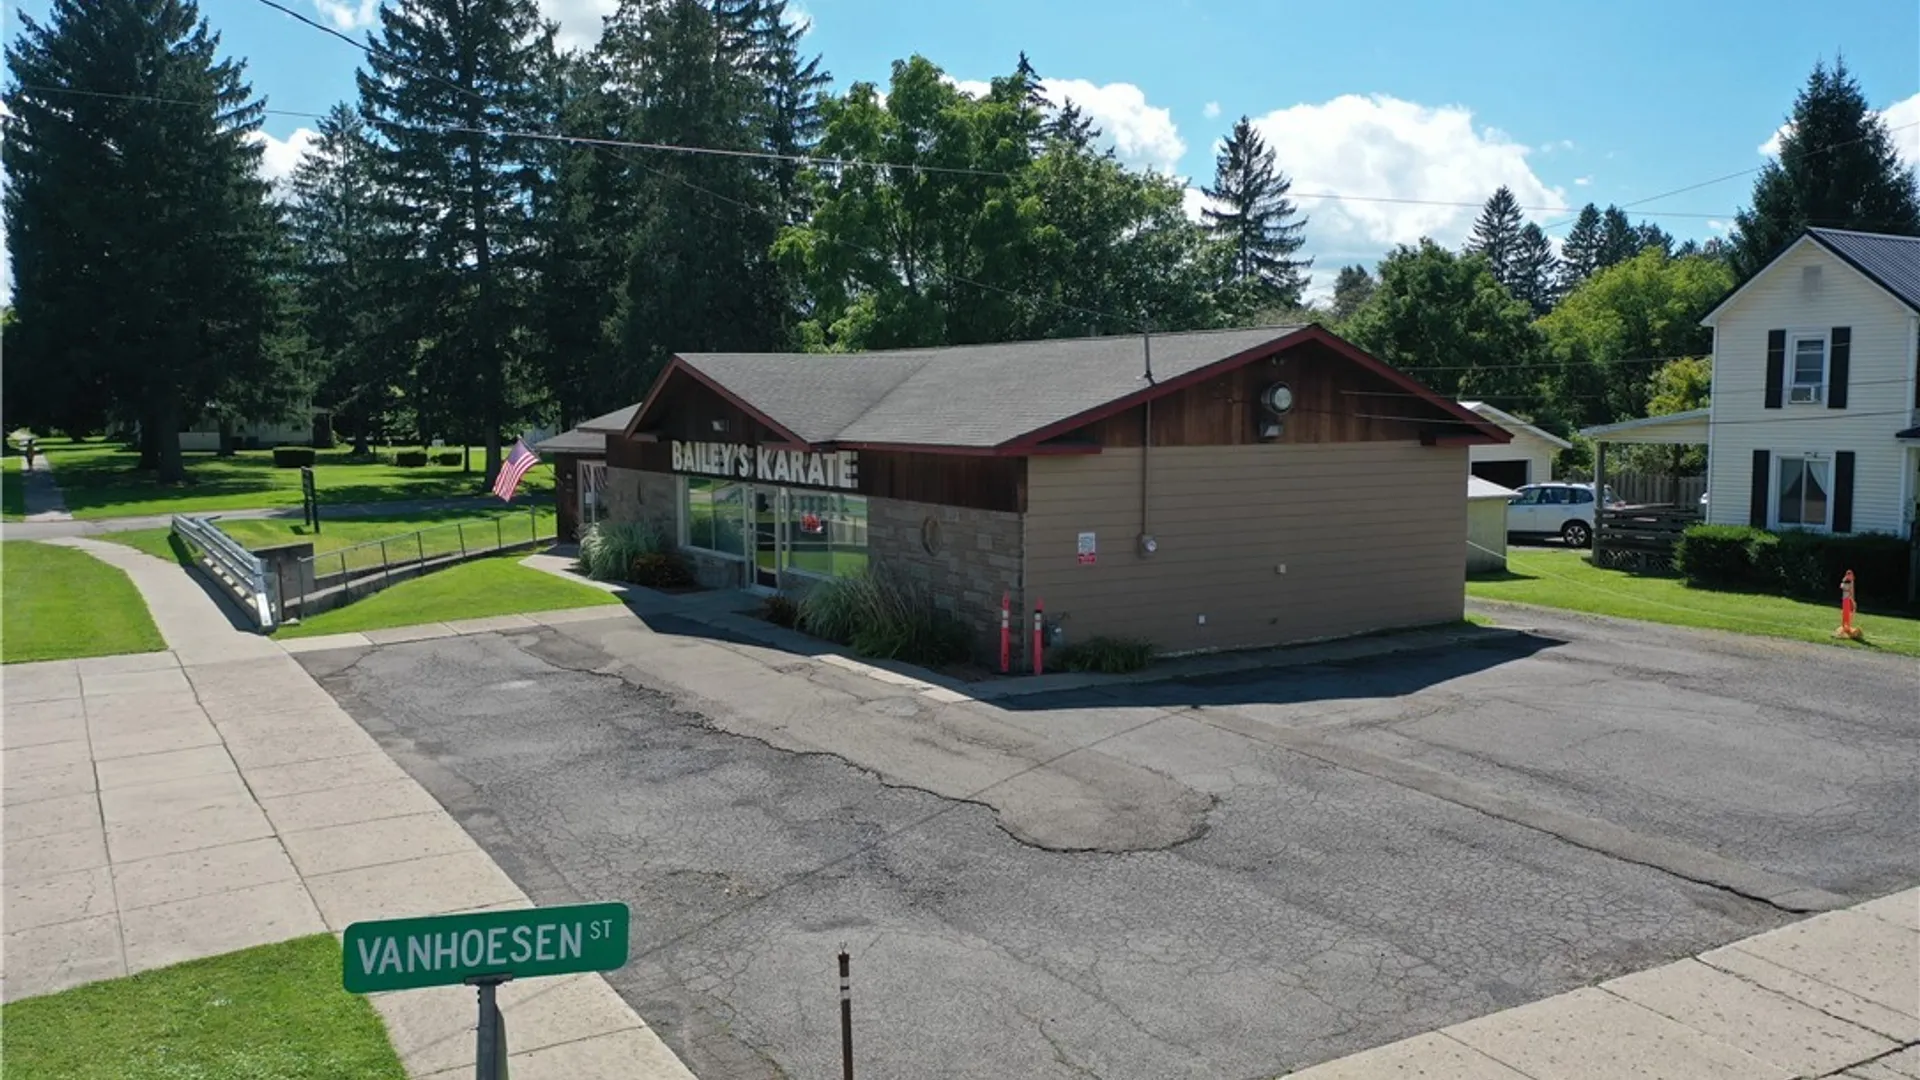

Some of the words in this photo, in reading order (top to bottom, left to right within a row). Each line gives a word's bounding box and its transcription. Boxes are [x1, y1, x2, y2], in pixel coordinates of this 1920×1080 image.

[671, 440, 753, 478] BAILEY'S
[756, 445, 859, 489] KARATE
[357, 922, 582, 975] VANHOESEN
[589, 918, 613, 939] ST
